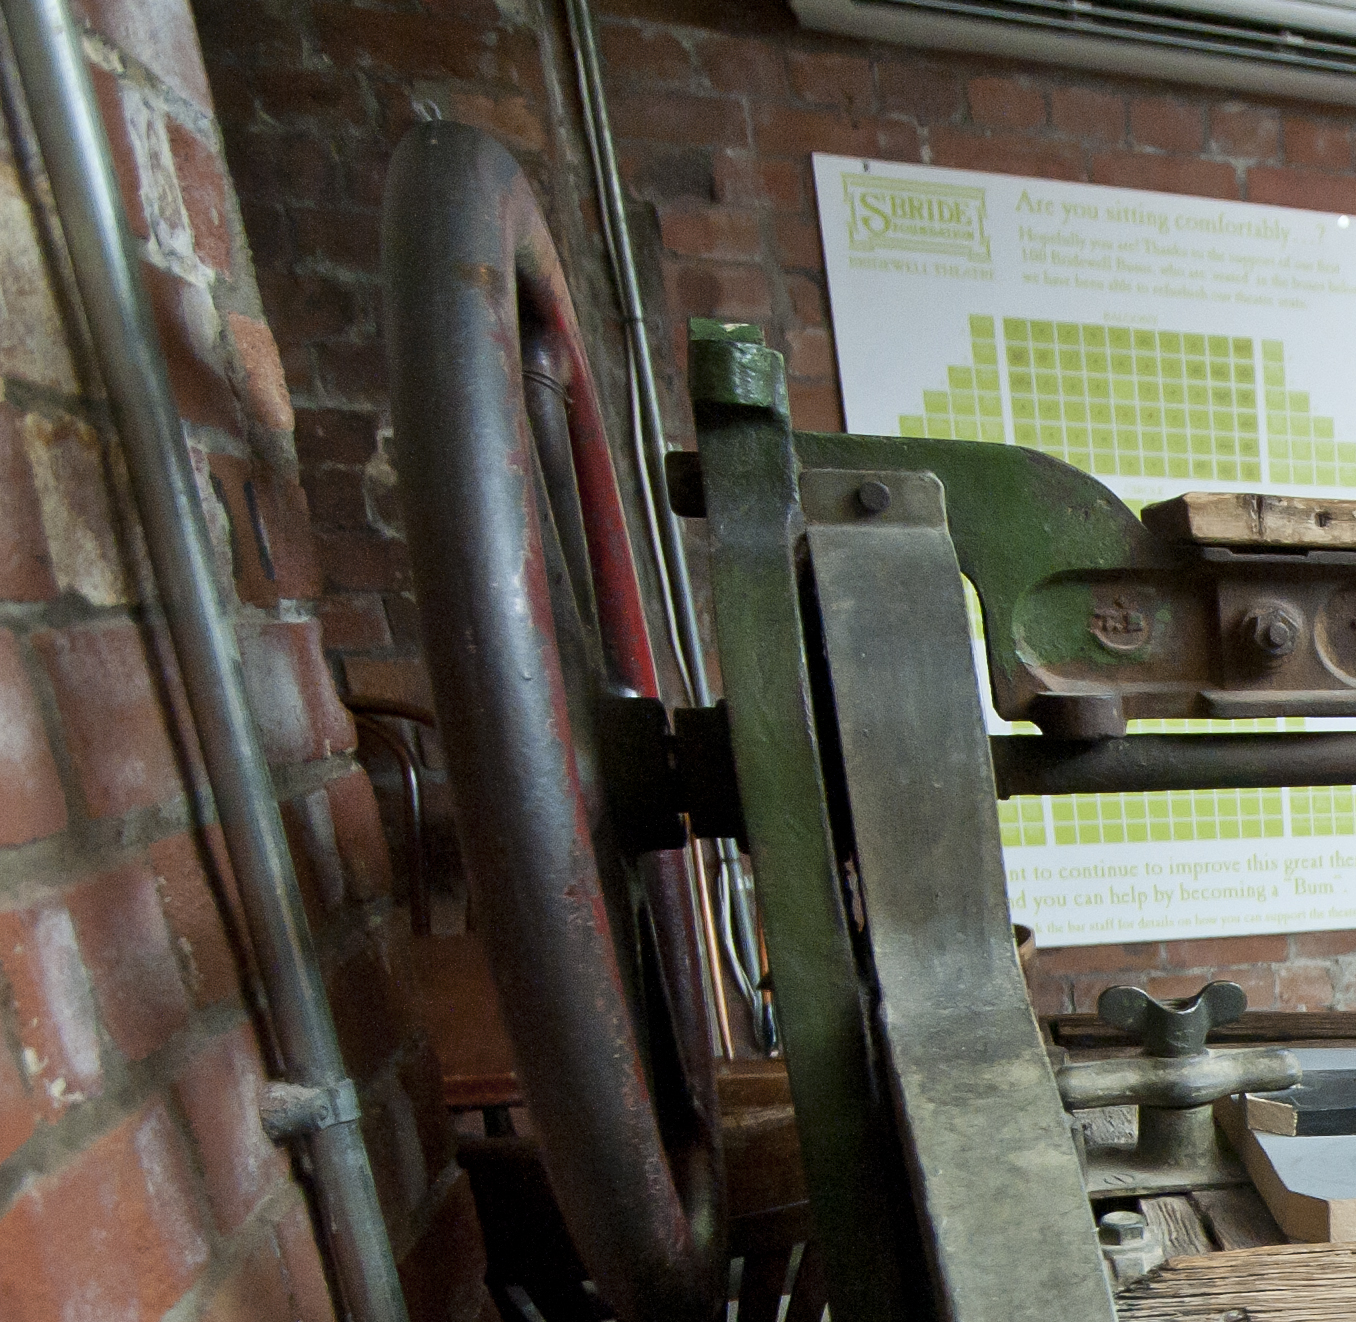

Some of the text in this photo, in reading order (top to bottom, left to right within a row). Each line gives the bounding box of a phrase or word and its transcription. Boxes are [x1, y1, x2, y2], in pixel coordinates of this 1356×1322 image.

[1015, 188, 1053, 215] Are
[1061, 203, 1099, 226] you
[1106, 199, 1170, 235] sitting
[1008, 867, 1026, 883] nt
[1033, 865, 1052, 881] to
[1058, 859, 1138, 880] continue
[1145, 861, 1162, 876] to
[1169, 856, 1241, 882] improve
[1247, 852, 1278, 871] this
[1284, 855, 1324, 877] great
[1033, 893, 1067, 916] you
[1073, 893, 1104, 907] can
[1109, 884, 1148, 911] help
[1153, 883, 1175, 909] by
[1180, 881, 1267, 903] becoming
[1271, 885, 1279, 897] a
[1047, 921, 1064, 935] the
[1068, 920, 1086, 932] bar
[1089, 916, 1114, 932] staff
[1118, 916, 1135, 930] for
[1138, 914, 1174, 928] details
[1177, 917, 1192, 927] on
[1195, 913, 1217, 926] how
[1220, 914, 1241, 929] you
[1244, 912, 1262, 923] can
[1265, 909, 1307, 925] support
[1309, 908, 1325, 921] the
